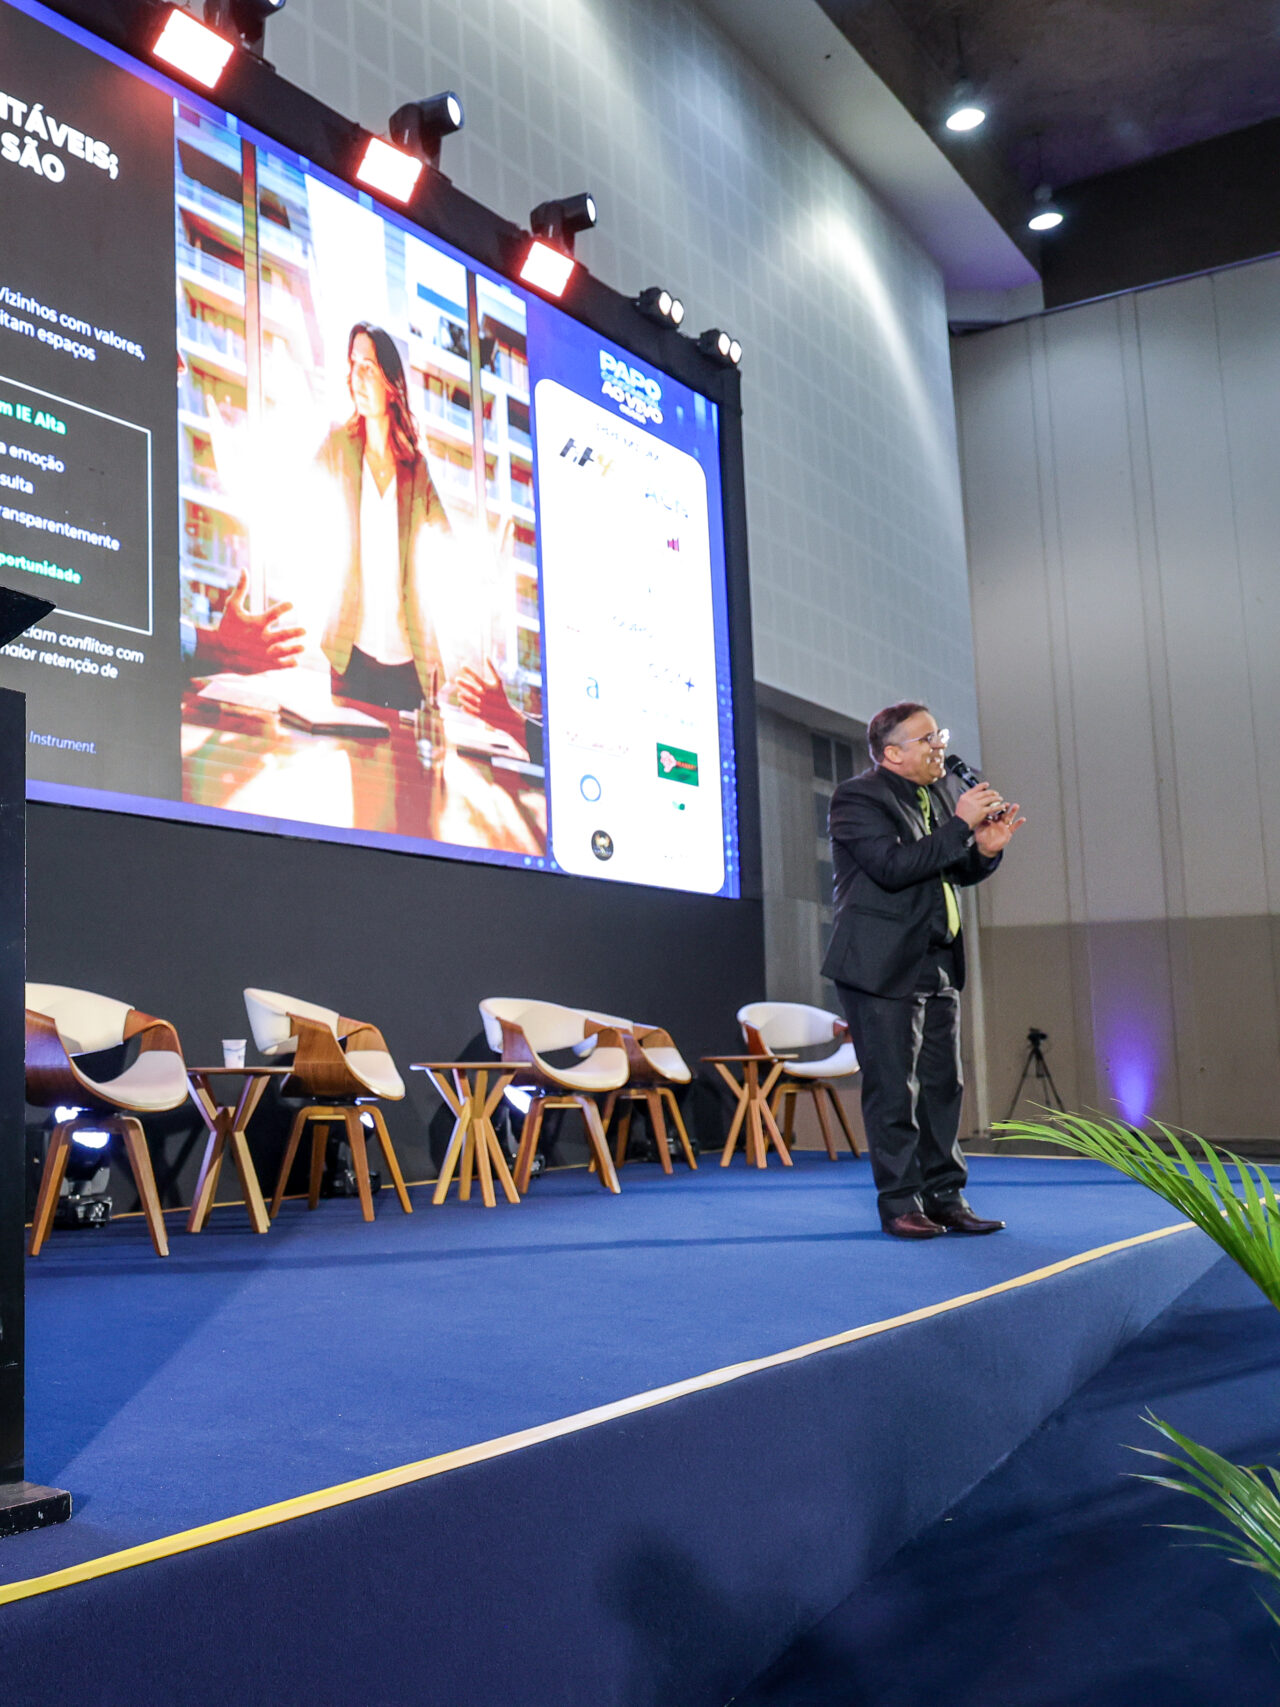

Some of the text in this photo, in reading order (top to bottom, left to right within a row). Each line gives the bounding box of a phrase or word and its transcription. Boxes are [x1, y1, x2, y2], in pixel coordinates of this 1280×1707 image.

[1, 131, 66, 183] SÃO
[37, 326, 97, 361] espaços
[59, 313, 92, 336] com
[94, 326, 146, 361] valores,
[599, 349, 662, 401] PAPO
[15, 403, 33, 424] IE
[33, 410, 68, 436] Alta
[9, 444, 66, 474] emoção
[39, 650, 100, 675] retenção
[100, 662, 119, 679] de
[59, 633, 115, 657] conflitos
[115, 646, 145, 664] com
